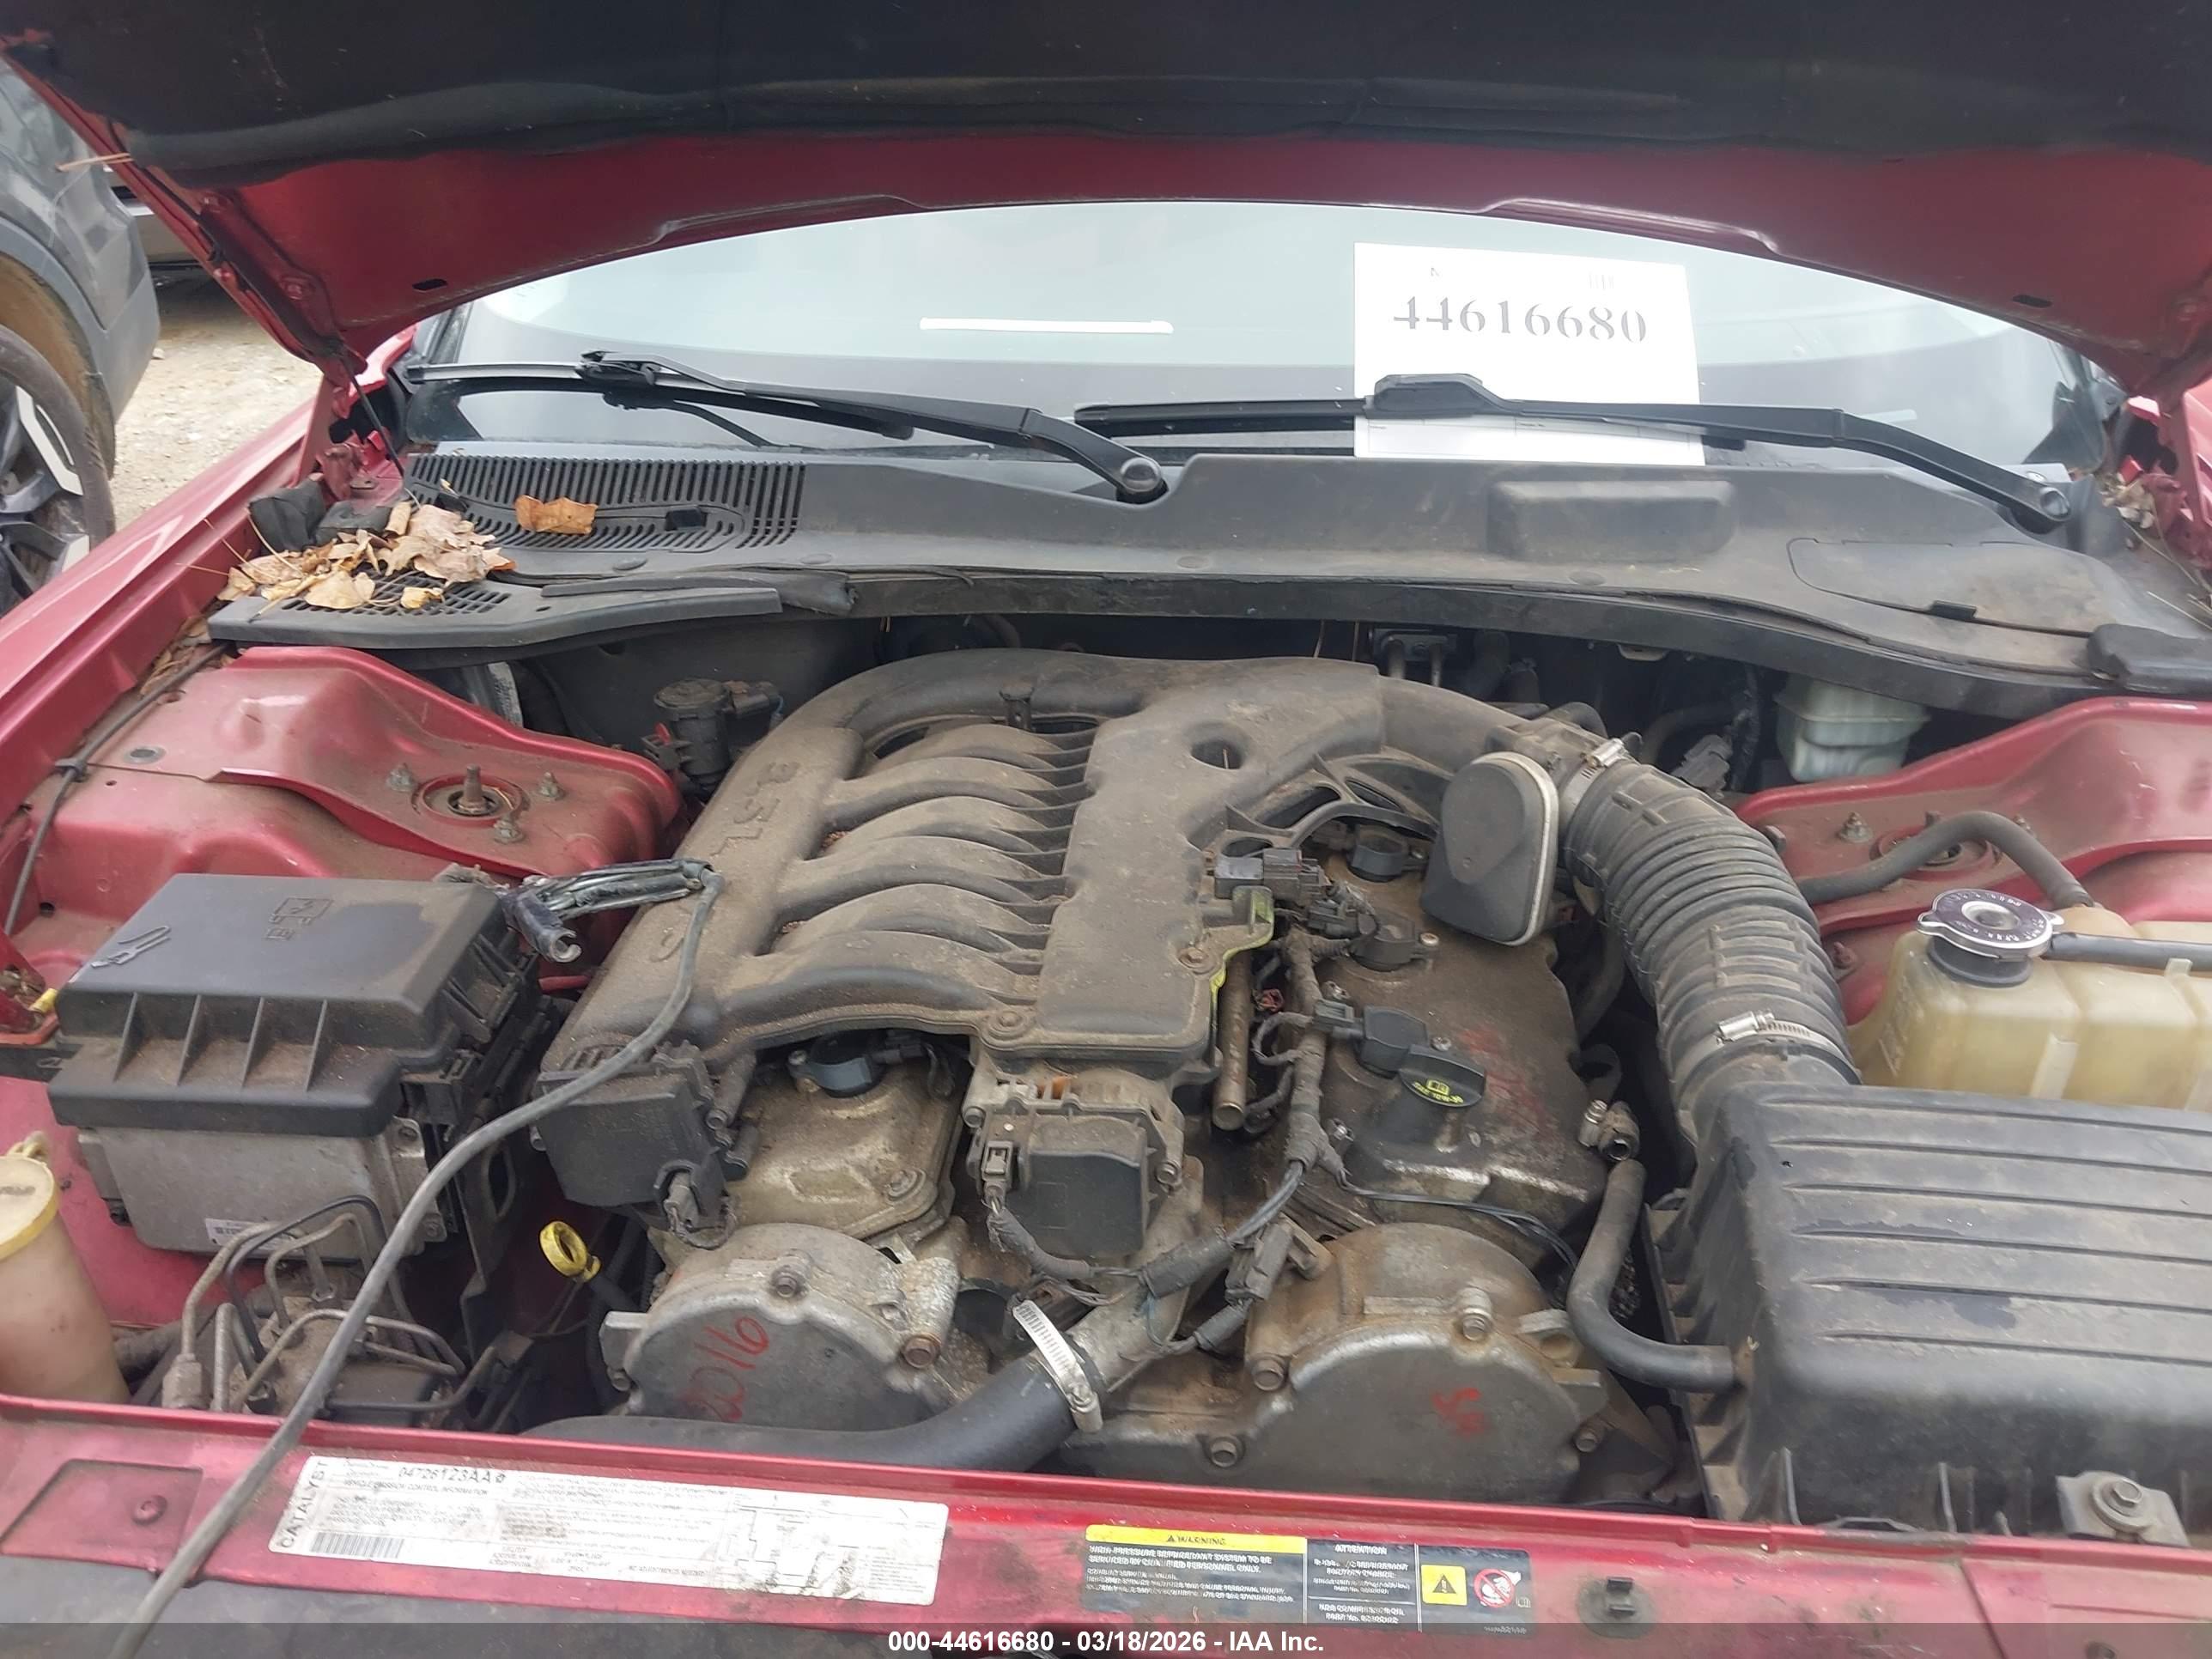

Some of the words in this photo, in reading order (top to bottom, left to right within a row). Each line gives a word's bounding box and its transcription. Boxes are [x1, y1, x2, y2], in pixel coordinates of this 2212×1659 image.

[1393, 295, 1647, 343] 44616680
[279, 1461, 328, 1549] CATALYST
[1176, 1534, 1227, 1546] WARNING
[1113, 1547, 1157, 1558] PRESSURE
[1212, 1553, 1247, 1563] SYSTEM
[1247, 1555, 1260, 1564] TO
[1260, 1556, 1273, 1565] BE
[1334, 1543, 1388, 1555] ATTENTION
[1141, 1558, 1187, 1569] QUAFIED
[1186, 1560, 1236, 1571] PERSONNEL
